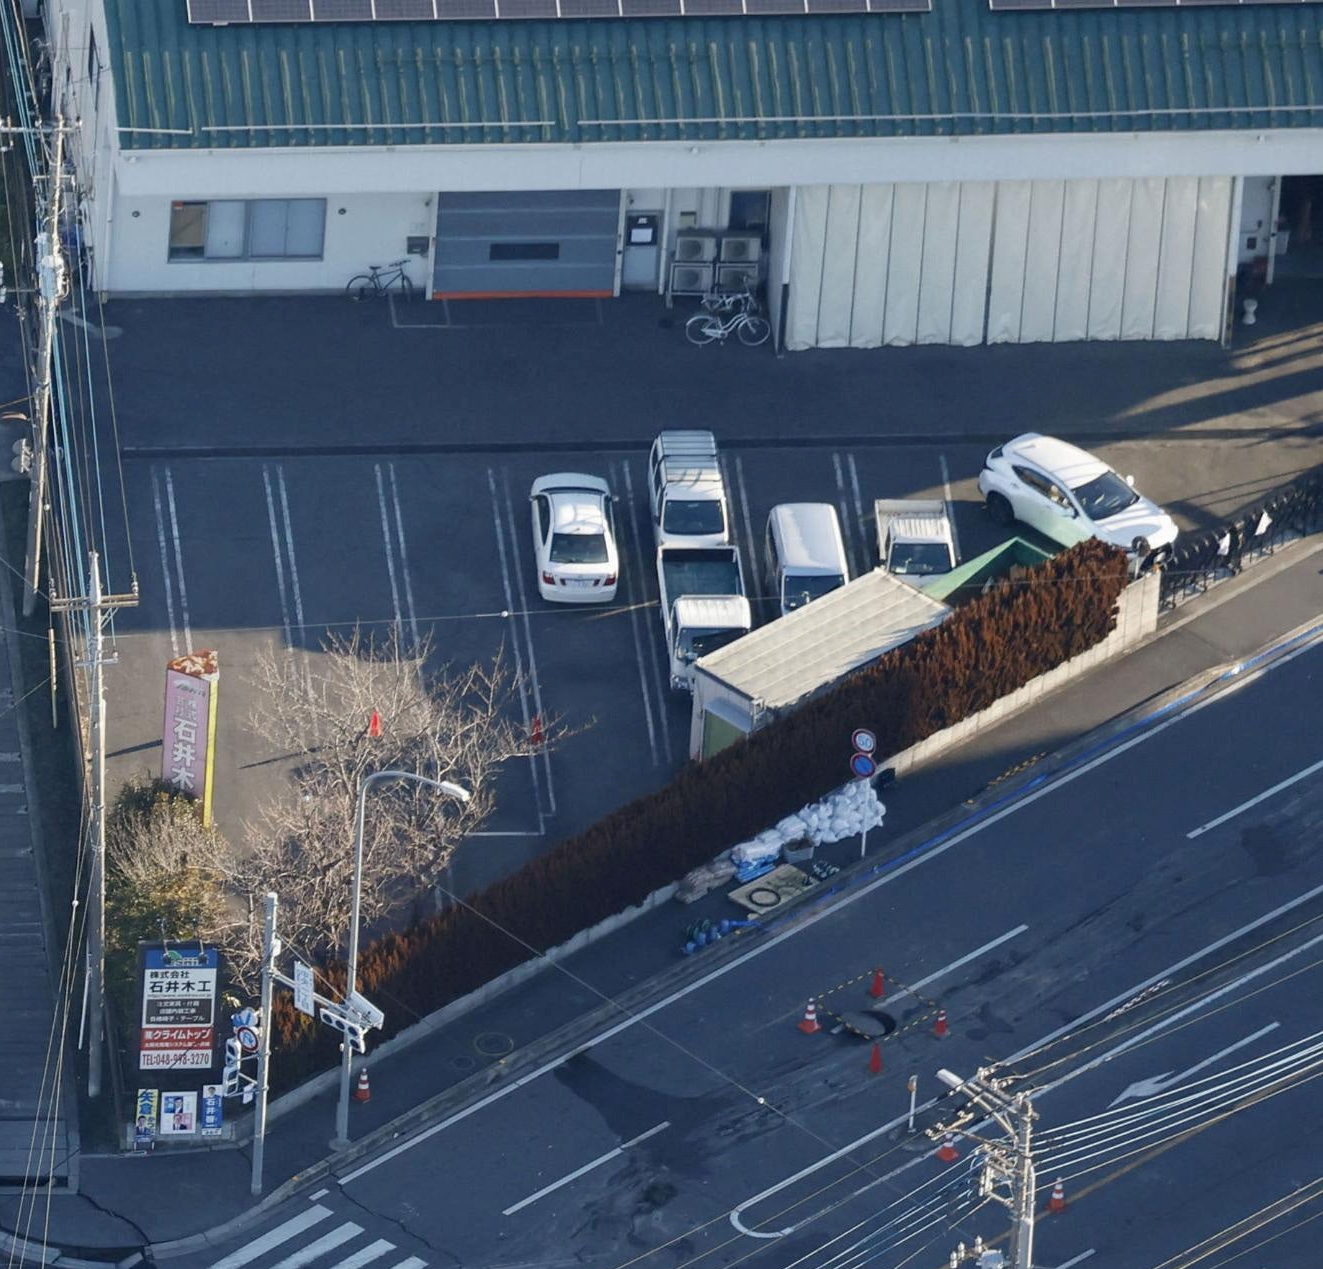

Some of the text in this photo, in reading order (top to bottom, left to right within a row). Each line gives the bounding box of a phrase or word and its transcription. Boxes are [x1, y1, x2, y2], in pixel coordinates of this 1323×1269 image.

[149, 970, 190, 979] 株式会社
[149, 980, 212, 993] 石井木工
